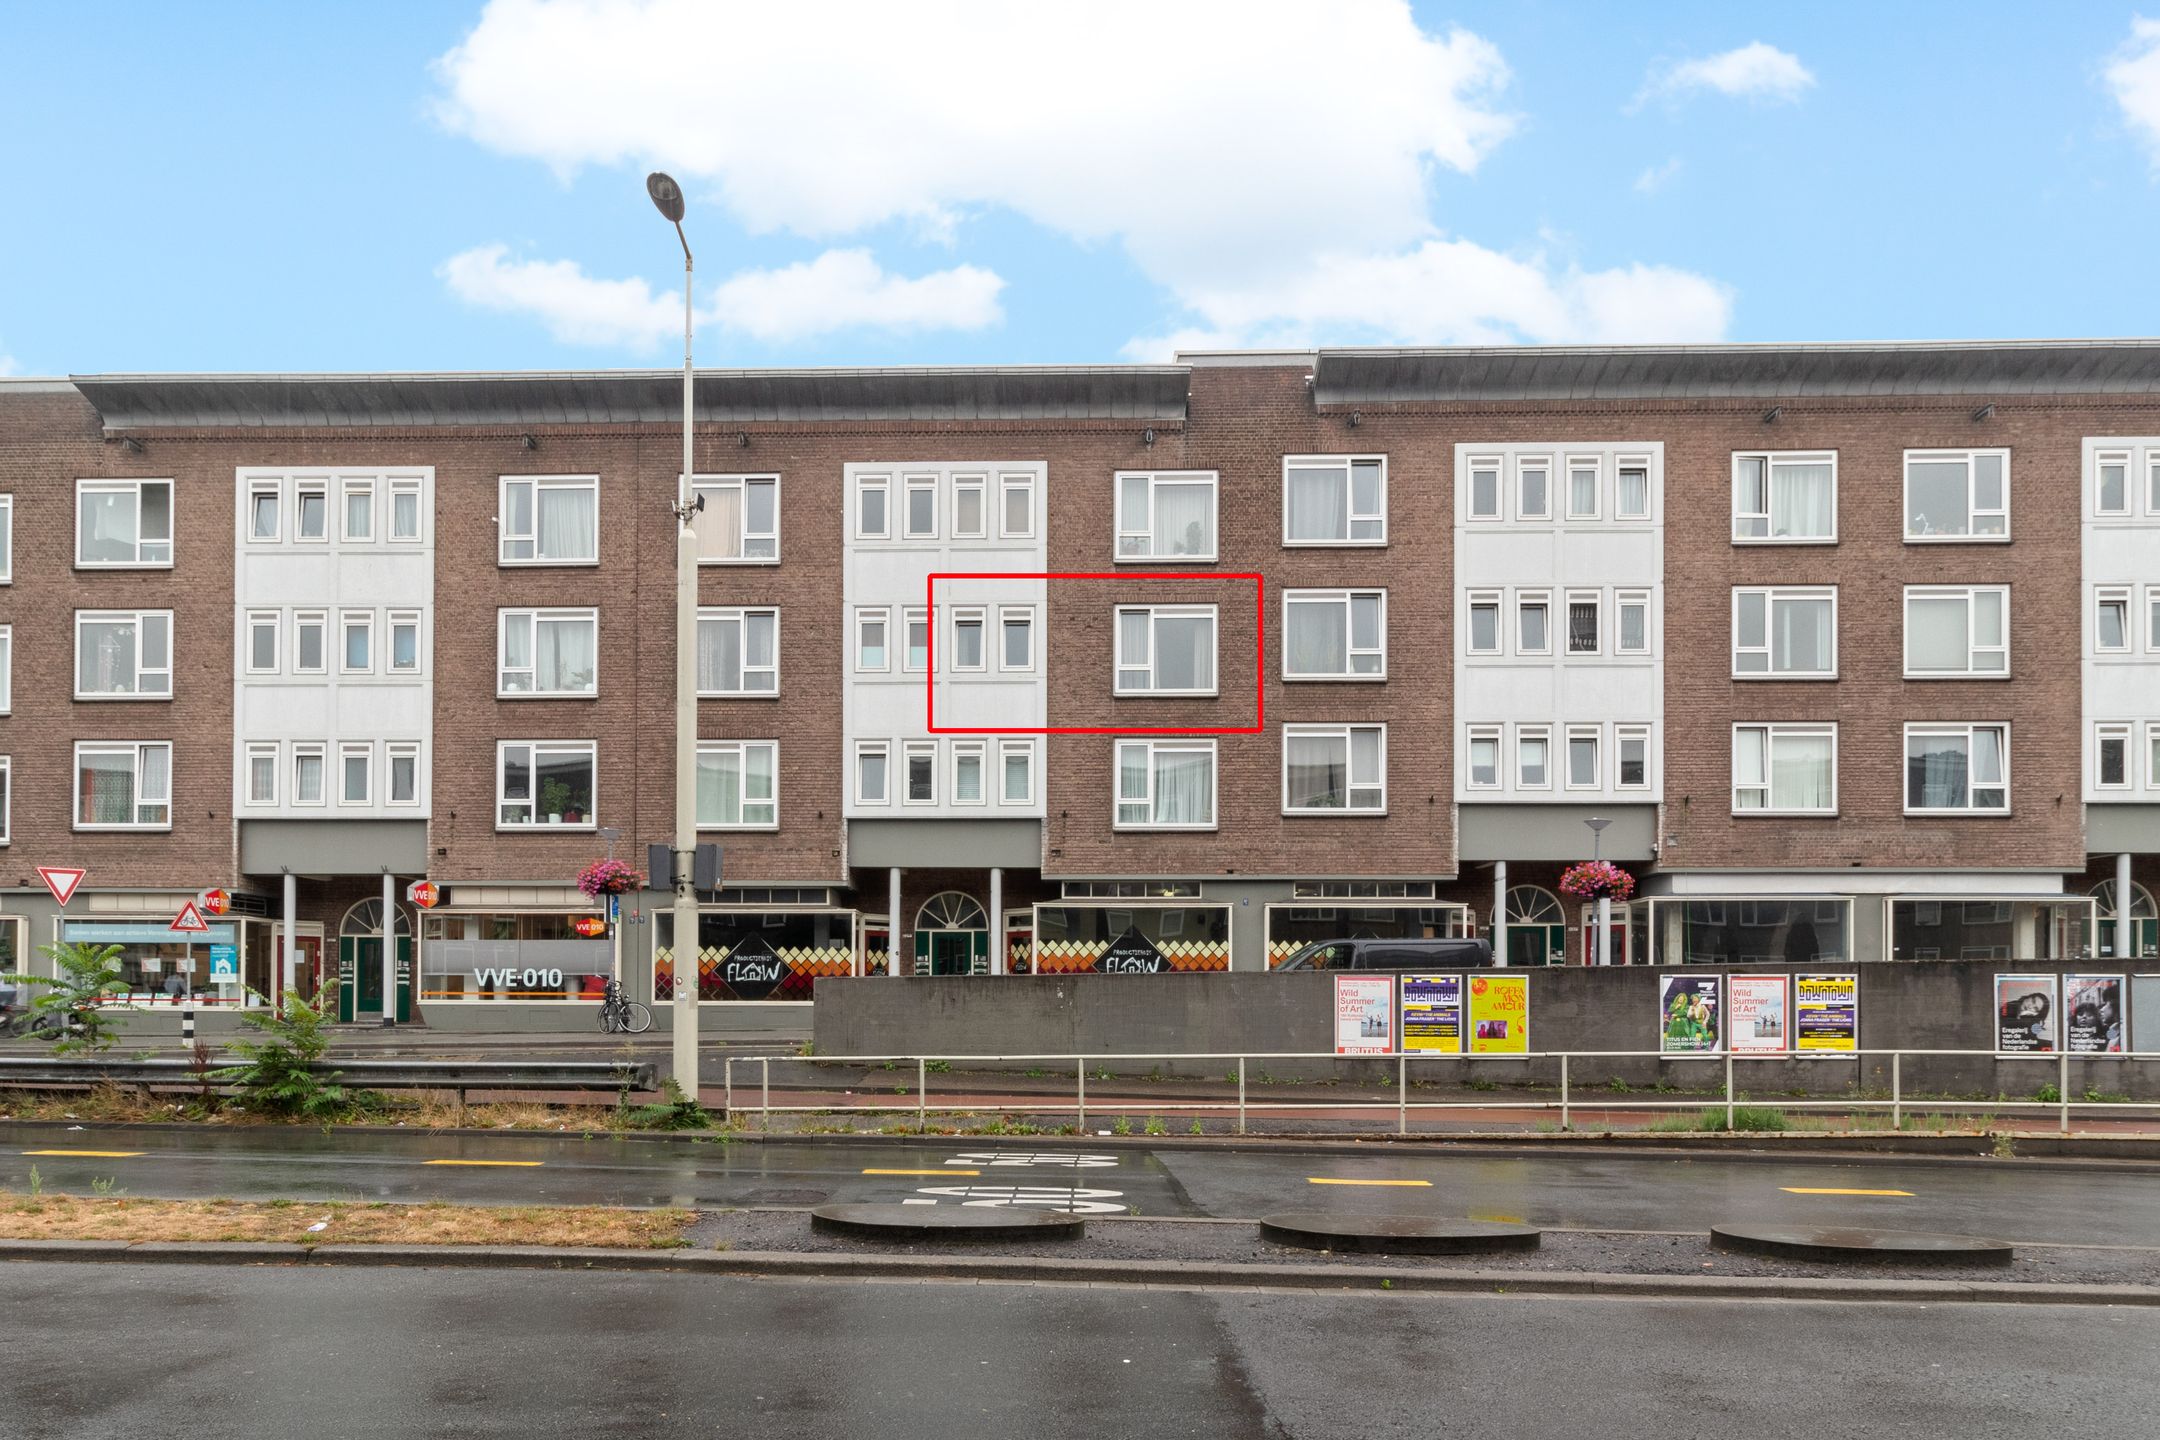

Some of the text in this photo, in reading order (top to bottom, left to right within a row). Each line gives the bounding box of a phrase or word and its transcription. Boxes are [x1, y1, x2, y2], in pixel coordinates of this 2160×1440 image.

[413, 890, 428, 900] VVE
[205, 897, 220, 906] VVE
[576, 924, 590, 932] VVE
[474, 968, 563, 987] VVE-010
[1799, 985, 1852, 1000] DOWNTOWN
